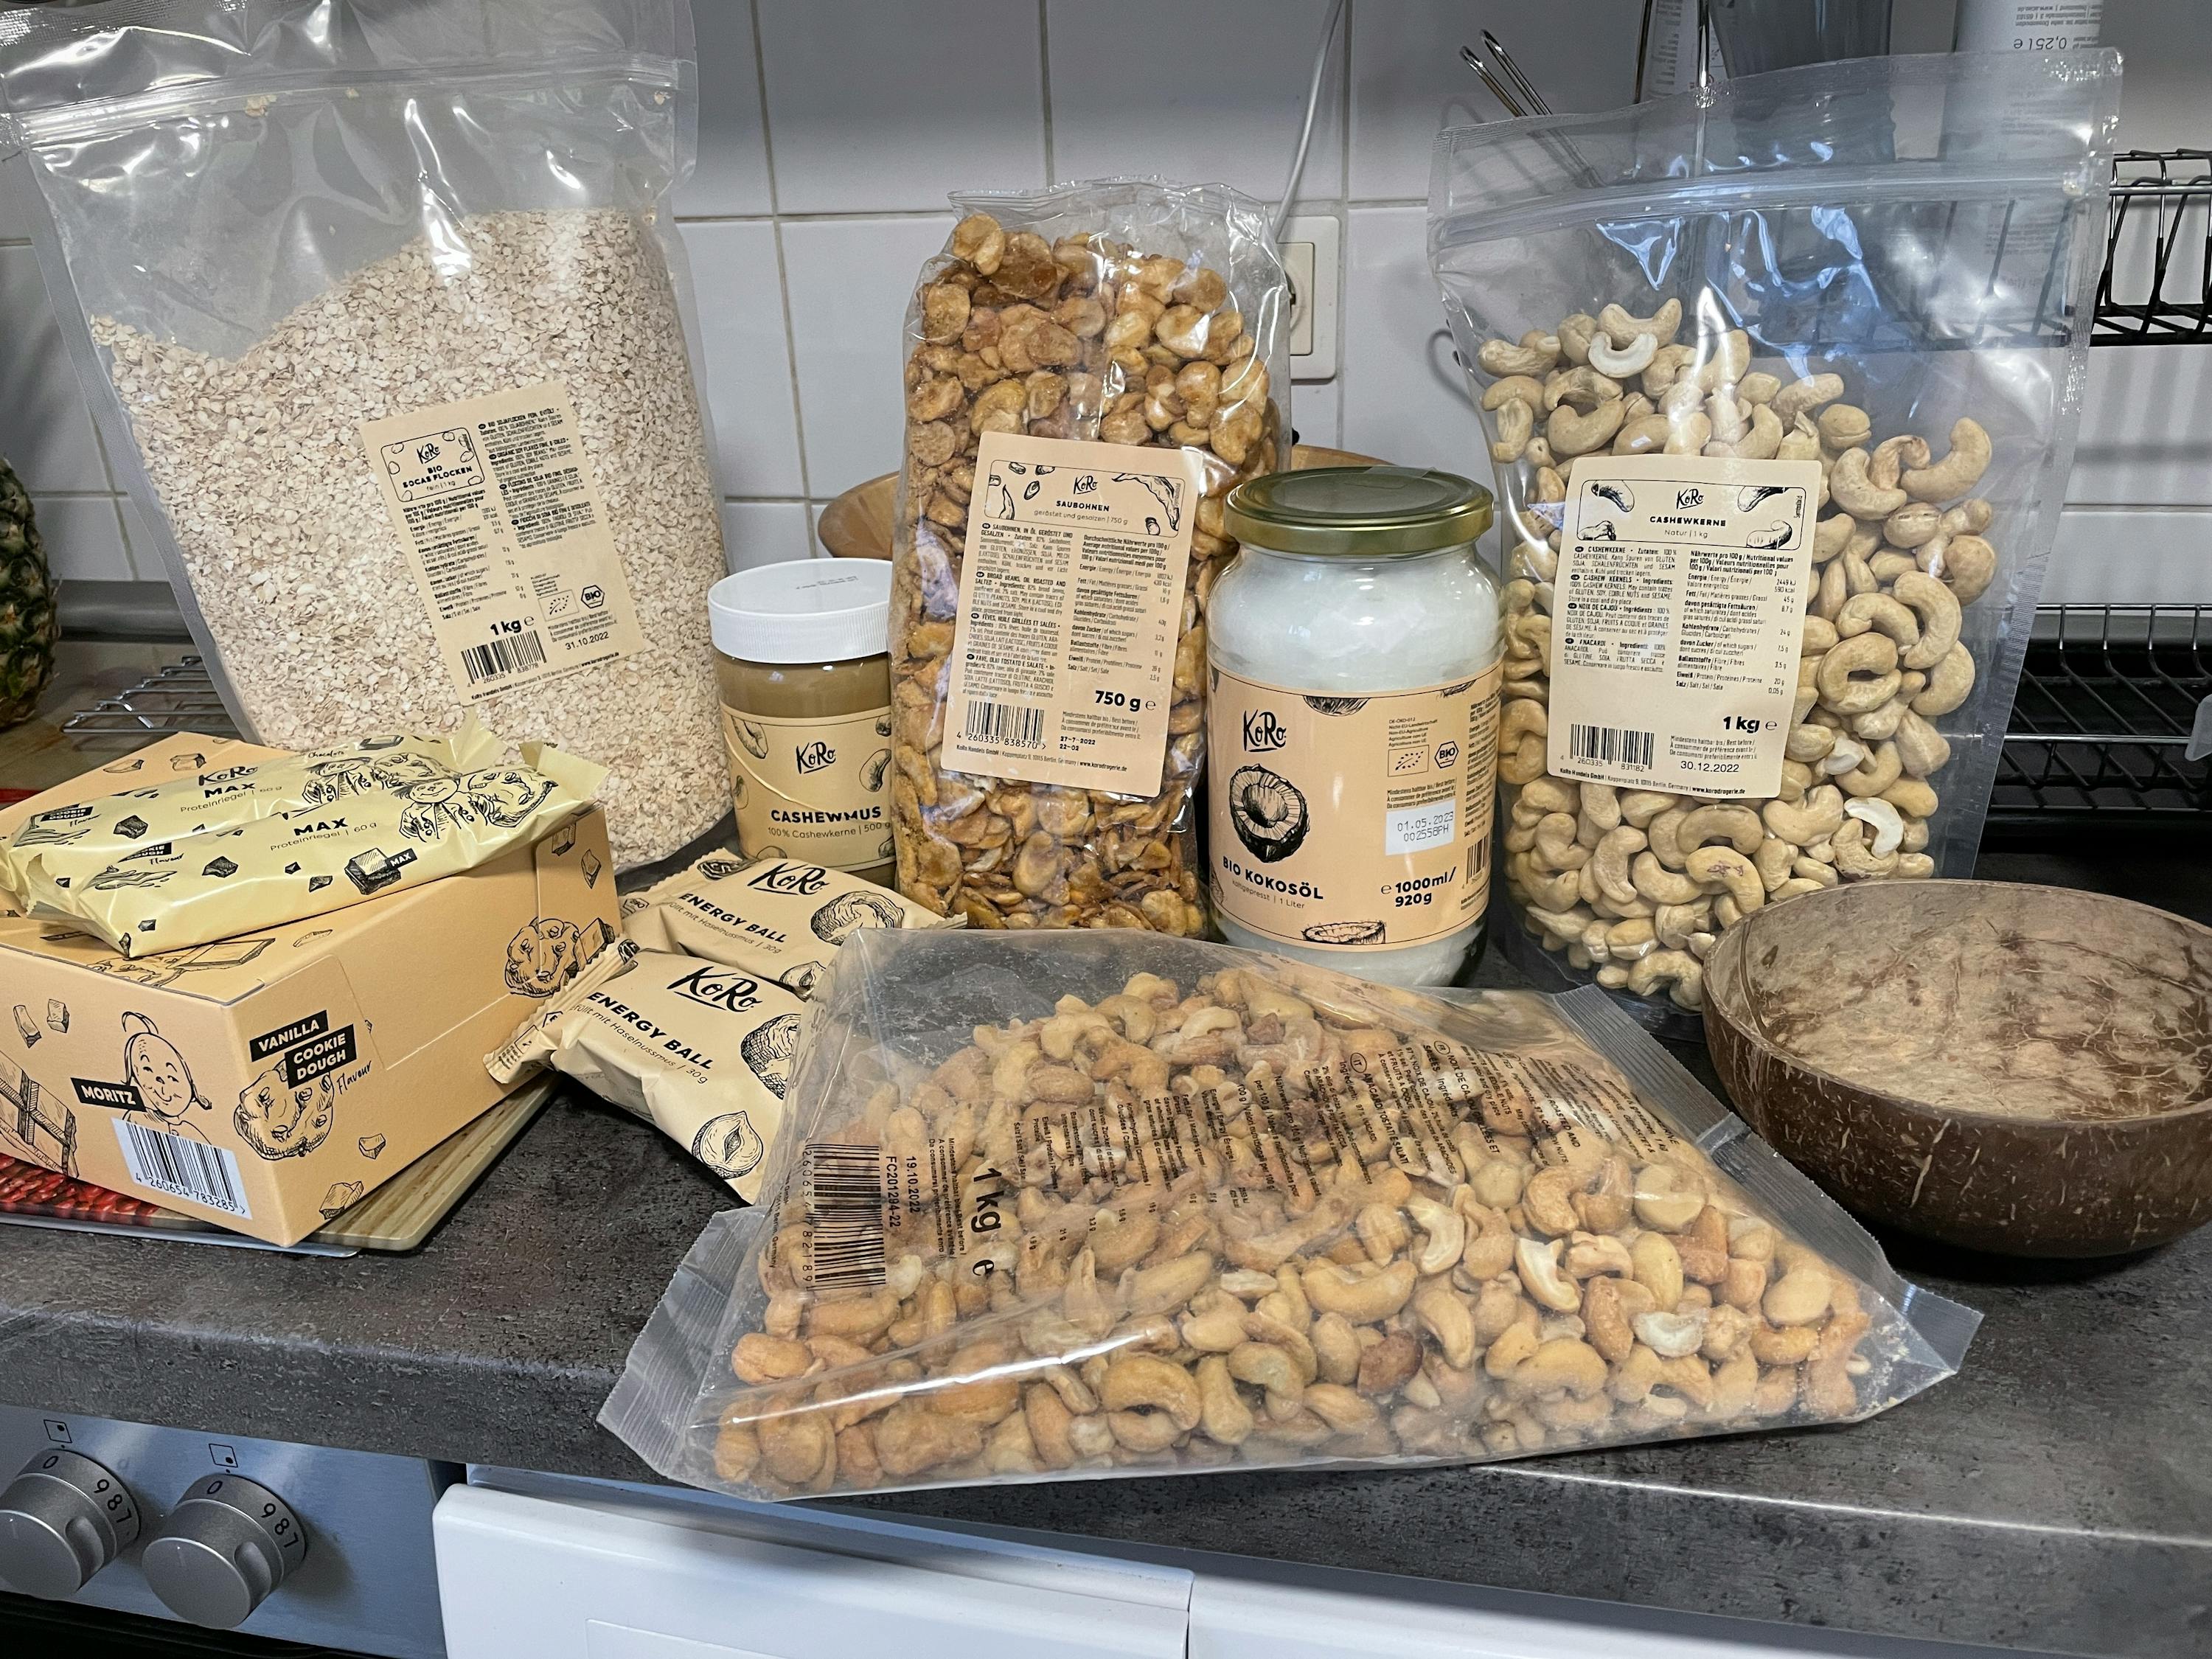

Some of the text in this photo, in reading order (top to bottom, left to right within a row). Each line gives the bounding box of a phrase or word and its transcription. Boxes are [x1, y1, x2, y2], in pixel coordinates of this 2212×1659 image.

[2036, 36, 2067, 50] 0,25
[428, 465, 442, 474] BIO
[1074, 475, 1098, 494] KoRo
[1056, 501, 1110, 511] SAUBOHNEN
[1676, 488, 1704, 509] KoRo
[1034, 509, 1062, 518] geröstet
[1077, 513, 1106, 523] gesalzen
[1649, 516, 1726, 526] CASHEWKERNE
[1665, 529, 1708, 539] Natur kg
[585, 590, 601, 601] BIO
[490, 619, 522, 636] 1 kg
[565, 631, 609, 650] 31.10.2022
[483, 673, 506, 684] 260335
[1096, 690, 1141, 712] 750 g
[1243, 709, 1287, 753] KoRo
[1723, 716, 1760, 734] 1 kg
[968, 734, 1000, 743] 260335
[1004, 739, 1037, 749] 838570
[796, 741, 837, 774] KoRo
[1439, 748, 1455, 759] BIO
[1577, 757, 1603, 766] 260335
[1621, 763, 1644, 772] 831182
[1680, 761, 1739, 773] 30.12.2022
[204, 783, 256, 799] MAX
[1692, 787, 1745, 795] www.korodrogerie.de
[180, 792, 246, 812] Proteinriegel
[771, 806, 881, 823] CASHEWMUS
[1397, 811, 1454, 832] 01.05.2023
[293, 817, 348, 835] MAX
[793, 828, 856, 838] Cashewkerne
[864, 823, 882, 832] 500
[1403, 824, 1449, 842] 002558PH
[271, 831, 340, 851] Proteinriegel
[390, 853, 412, 867] MAX
[747, 862, 830, 895] KoRo
[1223, 855, 1324, 900] BIO KOKOSÖL
[1286, 900, 1304, 909] Liter
[1395, 893, 1432, 907] 920g
[678, 893, 787, 943] ENERGY BALL
[699, 917, 754, 945] Haselnussmus
[667, 966, 762, 1012] KoRo
[258, 1019, 320, 1052] VANILLA
[586, 992, 714, 1069] ENERGY BALL
[593, 1012, 611, 1025] mit
[610, 1023, 676, 1067] Haselnussmus
[293, 1034, 347, 1064] COOKIE
[296, 1050, 347, 1080] DOUGH
[1447, 1054, 1460, 1071] NOIX
[1455, 1071, 1466, 1082] DE
[336, 1060, 372, 1096] Flavour
[80, 1085, 137, 1106] MORITZ
[1568, 1132, 1580, 1148] AND
[906, 1156, 920, 1213] 19.10.2022
[973, 1167, 1002, 1183] 1
[135, 1172, 234, 1212] 4 260654 783285
[886, 1156, 901, 1228] FC201294-22
[971, 1190, 1005, 1234] kg
